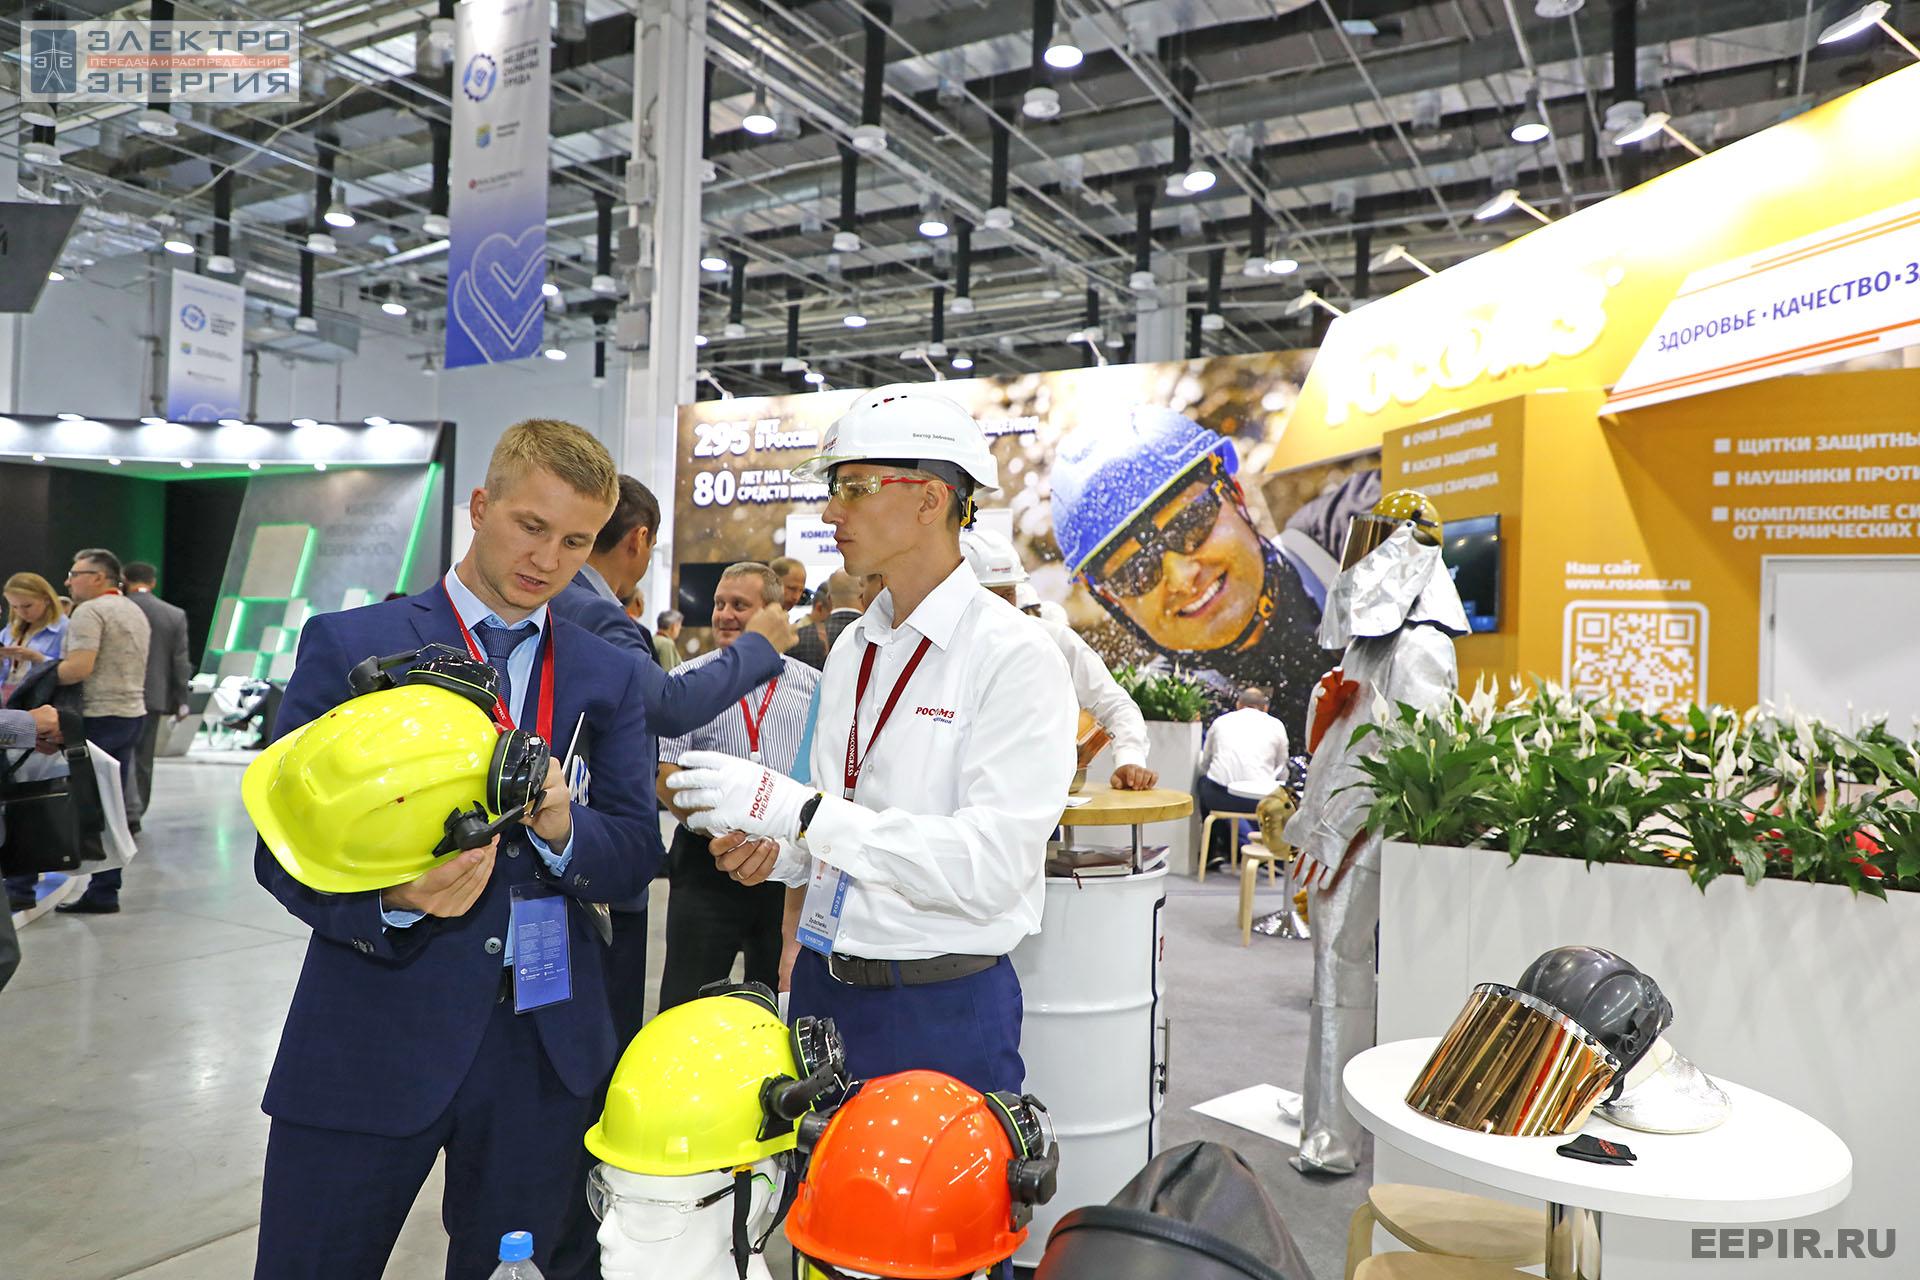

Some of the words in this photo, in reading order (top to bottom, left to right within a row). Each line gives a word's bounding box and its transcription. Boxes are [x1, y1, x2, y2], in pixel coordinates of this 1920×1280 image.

[1657, 309, 1756, 352] ЗДОРОВЬЕ
[1772, 270, 1892, 320] КАЧЕСТВО
[1904, 261, 1920, 285] З
[693, 421, 750, 458] 295
[1737, 436, 1811, 456] ЩИТКИ
[1735, 467, 1851, 486] НАУШНИКИ
[693, 470, 736, 507] 80
[737, 484, 790, 504] СРЕДСТВ
[1733, 503, 1892, 522] КОМПЛЕКСНЫЕ
[1732, 524, 1760, 540] ОТ
[1763, 522, 1912, 540] ТЕРМИЧЕСКИХ
[1565, 561, 1601, 575] Наш
[1603, 559, 1642, 575] сайт
[1564, 579, 1692, 592] www.rosomz.ru
